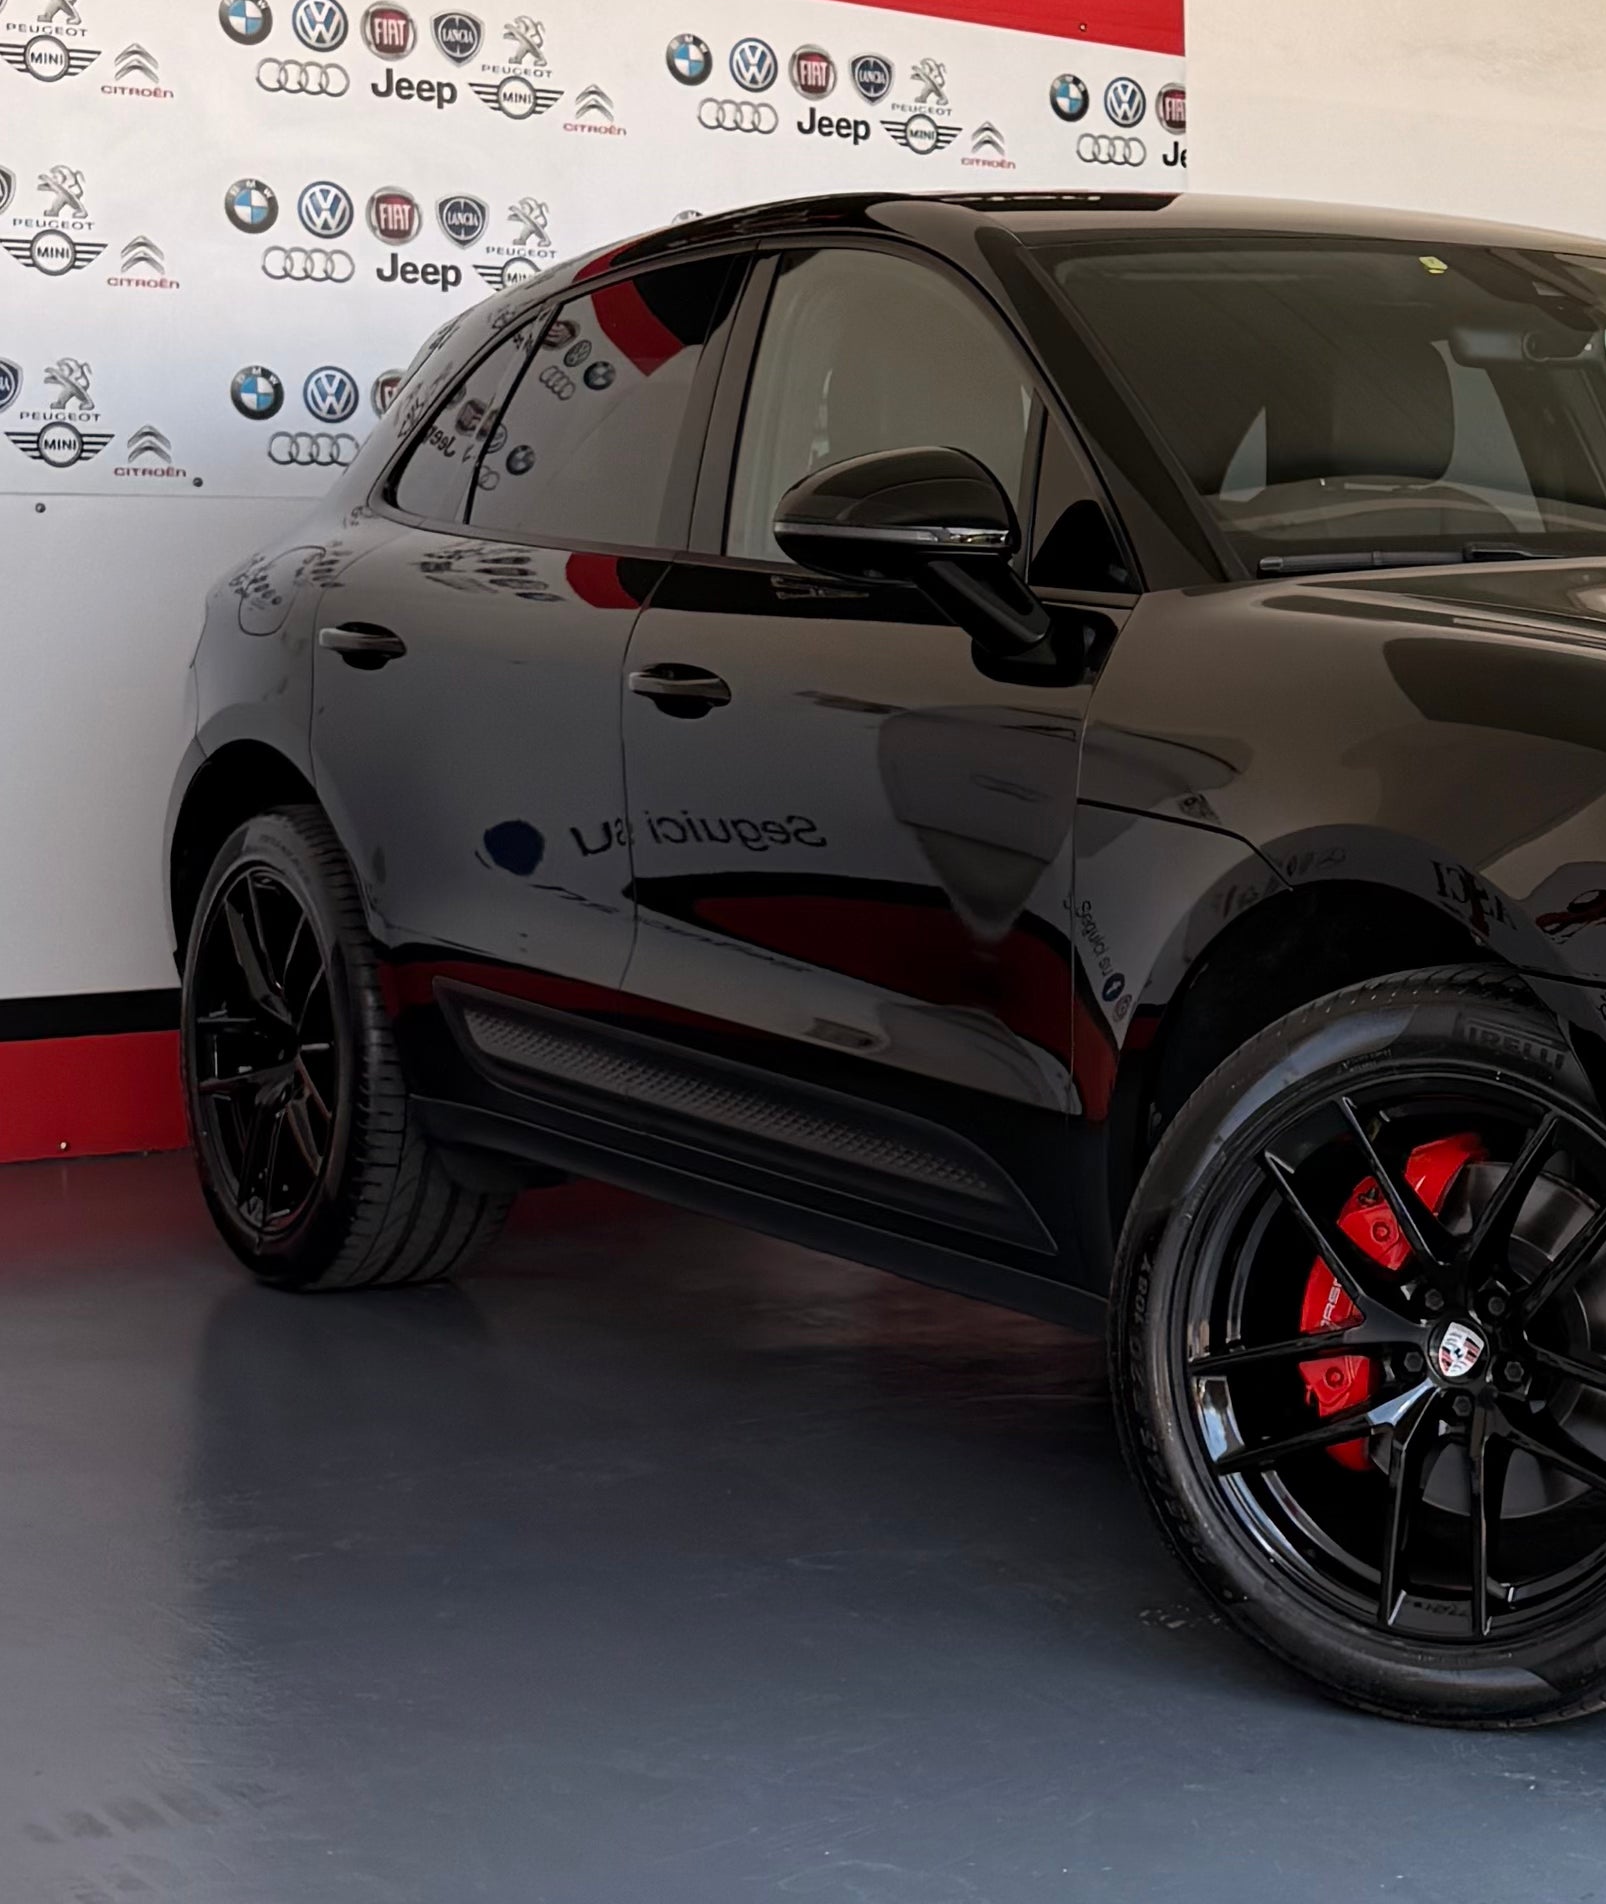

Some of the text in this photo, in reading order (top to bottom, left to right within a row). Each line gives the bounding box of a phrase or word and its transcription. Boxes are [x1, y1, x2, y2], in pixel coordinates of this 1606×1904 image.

[5, 22, 88, 37] PEUGEOT
[373, 17, 407, 47] FIAT
[30, 51, 64, 65] MINI
[481, 63, 553, 78] PEUGEOT
[799, 59, 828, 87] FIAT
[371, 68, 458, 109] Jeep
[502, 90, 532, 105] MINI
[890, 102, 953, 117] PEUGEOT
[796, 106, 871, 146] Jeep
[908, 128, 936, 141] MINI
[12, 217, 96, 231] PEUGEOT
[378, 202, 411, 231] FIAT
[37, 246, 70, 259] MINI
[485, 245, 558, 259] PEUGEOT
[376, 252, 462, 293] Jeep
[19, 411, 102, 422] PEUGEOT
[44, 438, 77, 451] MINI
